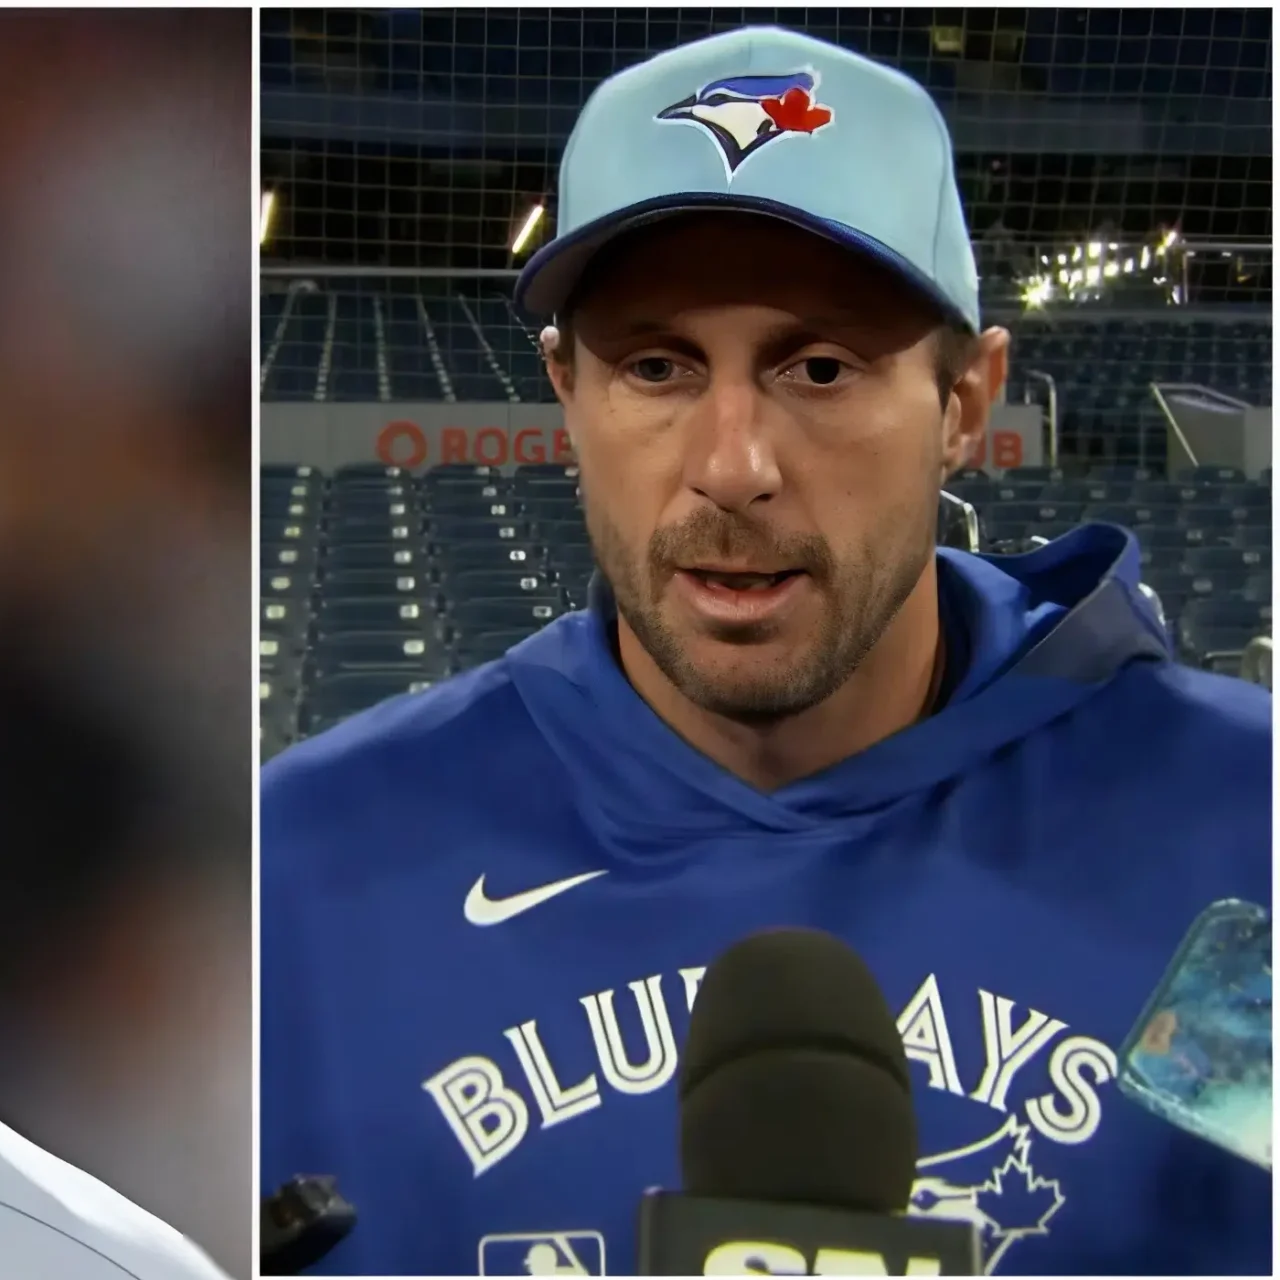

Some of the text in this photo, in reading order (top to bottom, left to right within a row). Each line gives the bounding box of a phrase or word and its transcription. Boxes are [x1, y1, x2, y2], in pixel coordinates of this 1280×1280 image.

[440, 427, 1024, 468] ROGE UB
[421, 966, 1118, 1179] BLU AYS
